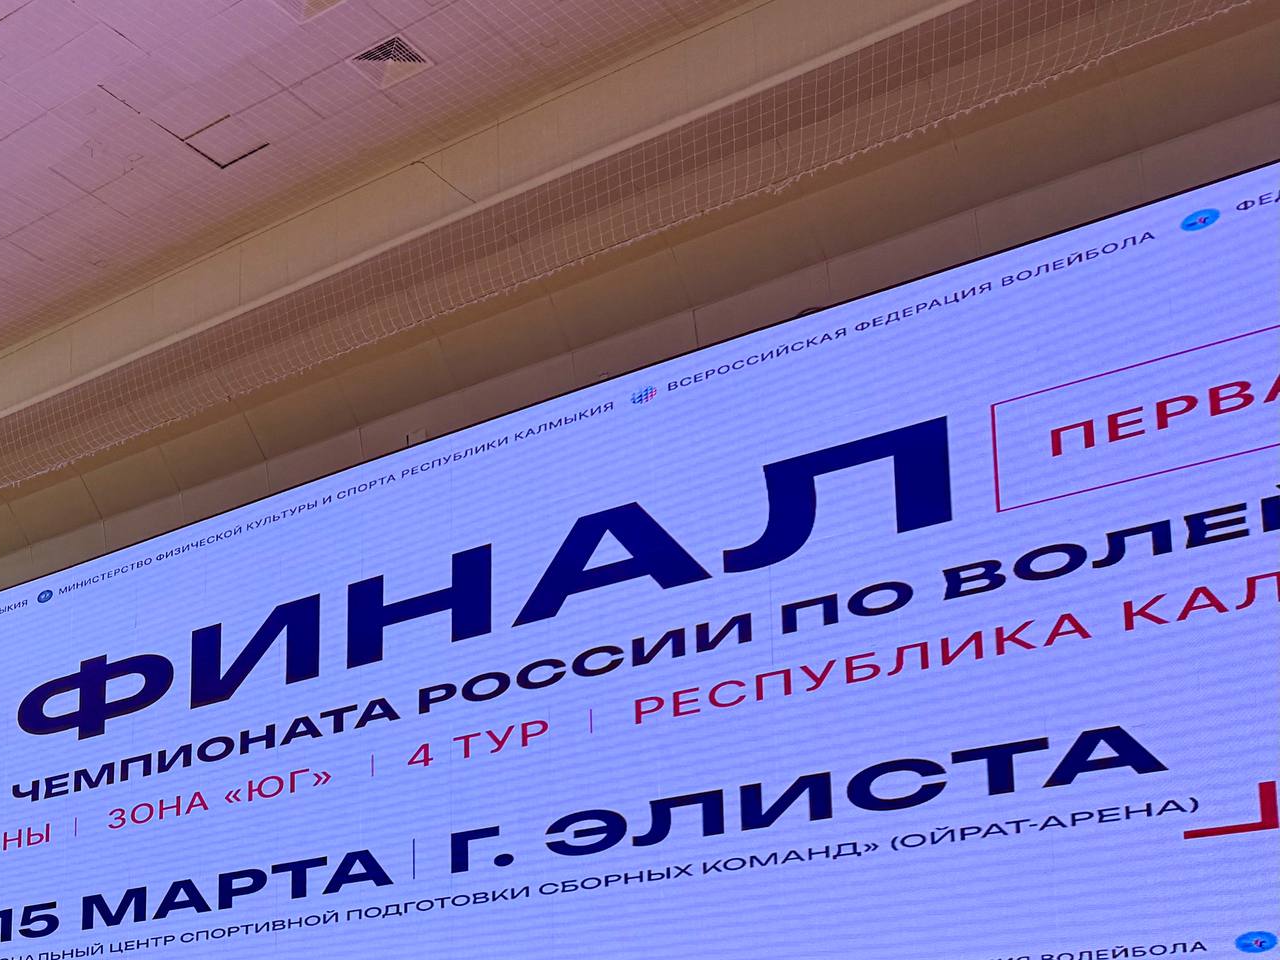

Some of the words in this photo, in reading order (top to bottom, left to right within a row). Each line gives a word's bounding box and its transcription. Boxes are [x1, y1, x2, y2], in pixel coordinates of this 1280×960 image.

[667, 327, 848, 392] ВСЕРОССИЙСКАЯ
[853, 281, 993, 332] ФЕДЕРАЦИЯ
[1001, 231, 1156, 288] ВОЛЕЙБОЛА
[58, 557, 153, 596] МИНИСТЕРСТВО
[155, 524, 243, 562] ФИЗИЧЕСКОЙ
[246, 499, 318, 532] КУЛЬТУРЫ
[322, 494, 332, 506] И
[336, 473, 397, 500] СПОРТА
[400, 435, 509, 481] РЕСПУБЛИКИ
[513, 401, 614, 442] КАЛМЫКИЯ
[17, 415, 954, 740] ФИНАЛ
[11, 697, 401, 803] ЧЕМПИОНАТА
[418, 612, 753, 716] РОССИИ
[780, 580, 914, 636] ПО
[407, 742, 434, 767] 4
[452, 719, 549, 759] ТУР
[634, 612, 1093, 725] РЕСПУБЛИКА
[107, 791, 209, 830] ЗОНА
[224, 767, 332, 804] «ЮГ»
[109, 934, 177, 954] ЦЕНТР
[179, 909, 339, 944] СПОРТИВНОЙ
[346, 885, 530, 922] ПОДГОТОВКИ
[538, 863, 694, 896] СБОРНЫХ
[702, 841, 880, 876] КОМАНД»
[890, 796, 1200, 852] (ОЙРАТ-АРЕНА)
[450, 825, 515, 875] Г.
[544, 725, 1170, 857] ЭЛИСТА
[81, 848, 395, 931] МАРТА
